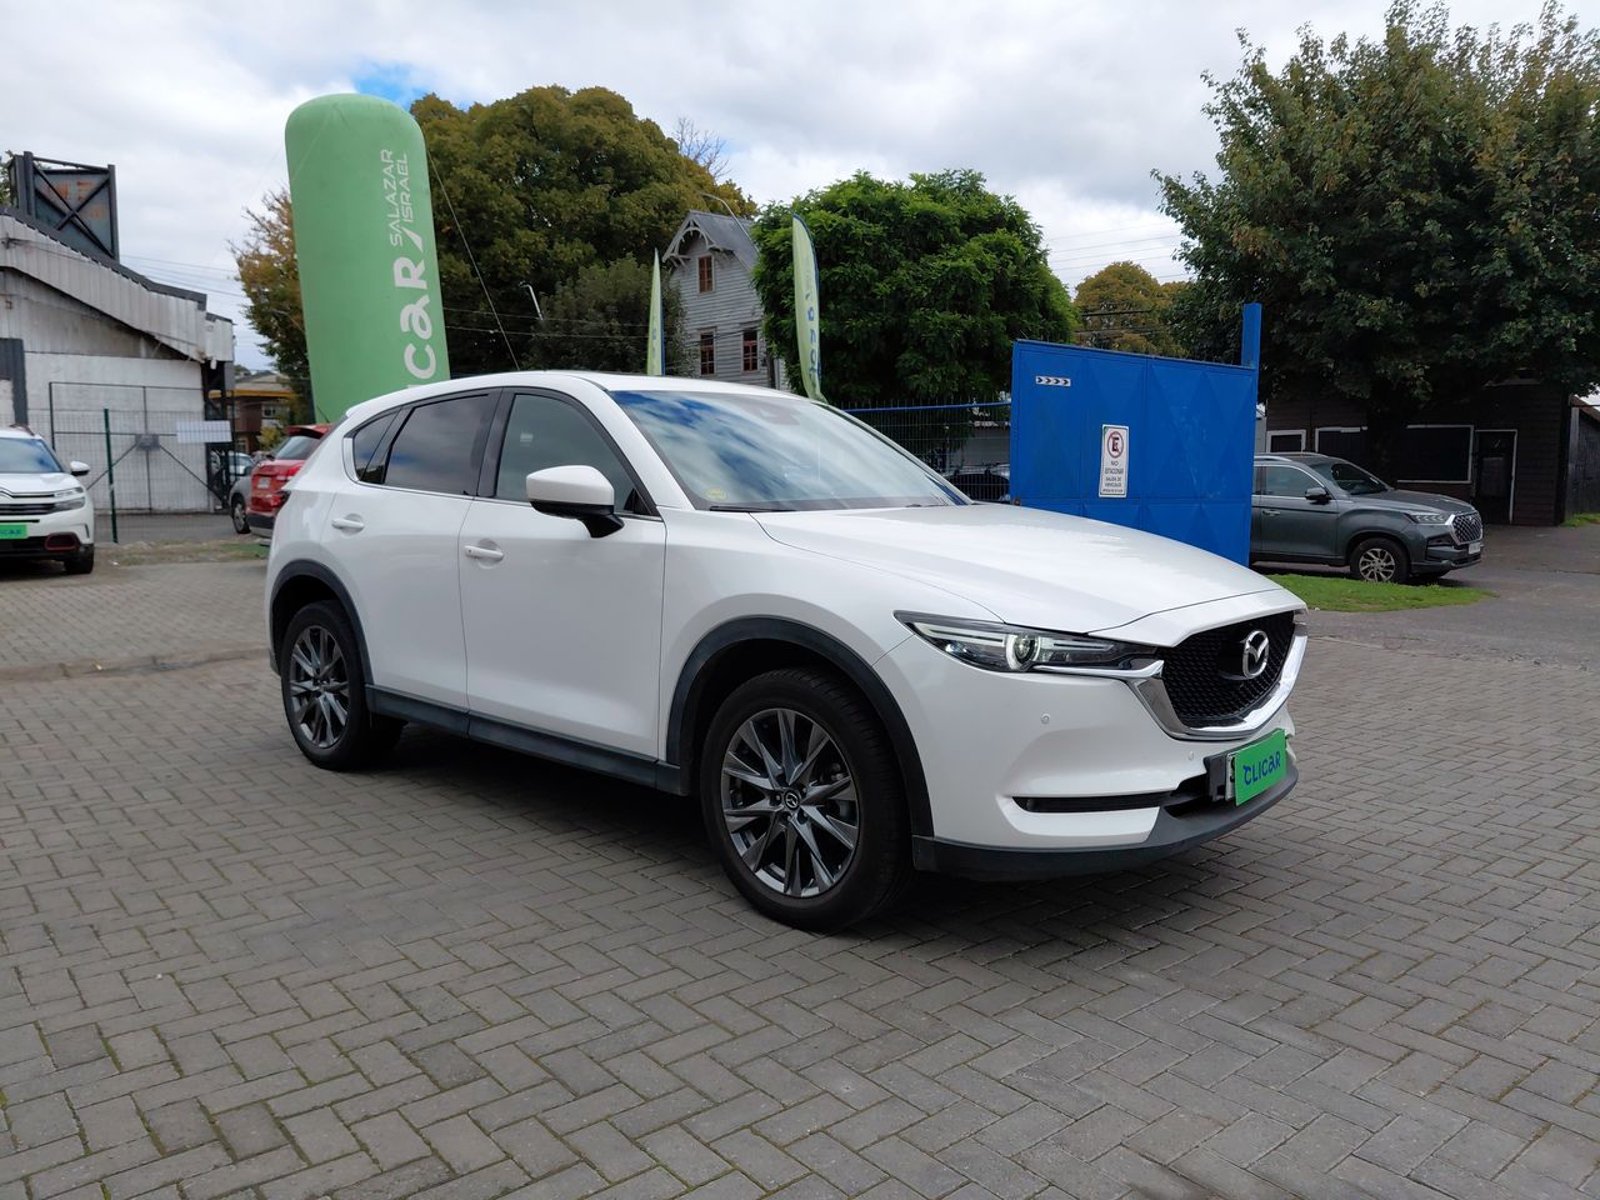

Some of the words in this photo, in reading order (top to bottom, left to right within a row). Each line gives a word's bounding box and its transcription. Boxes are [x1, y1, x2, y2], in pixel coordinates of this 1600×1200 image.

[381, 149, 402, 247] SALAZAR
[397, 153, 413, 223] ISRAEL
[393, 256, 436, 388] CaR
